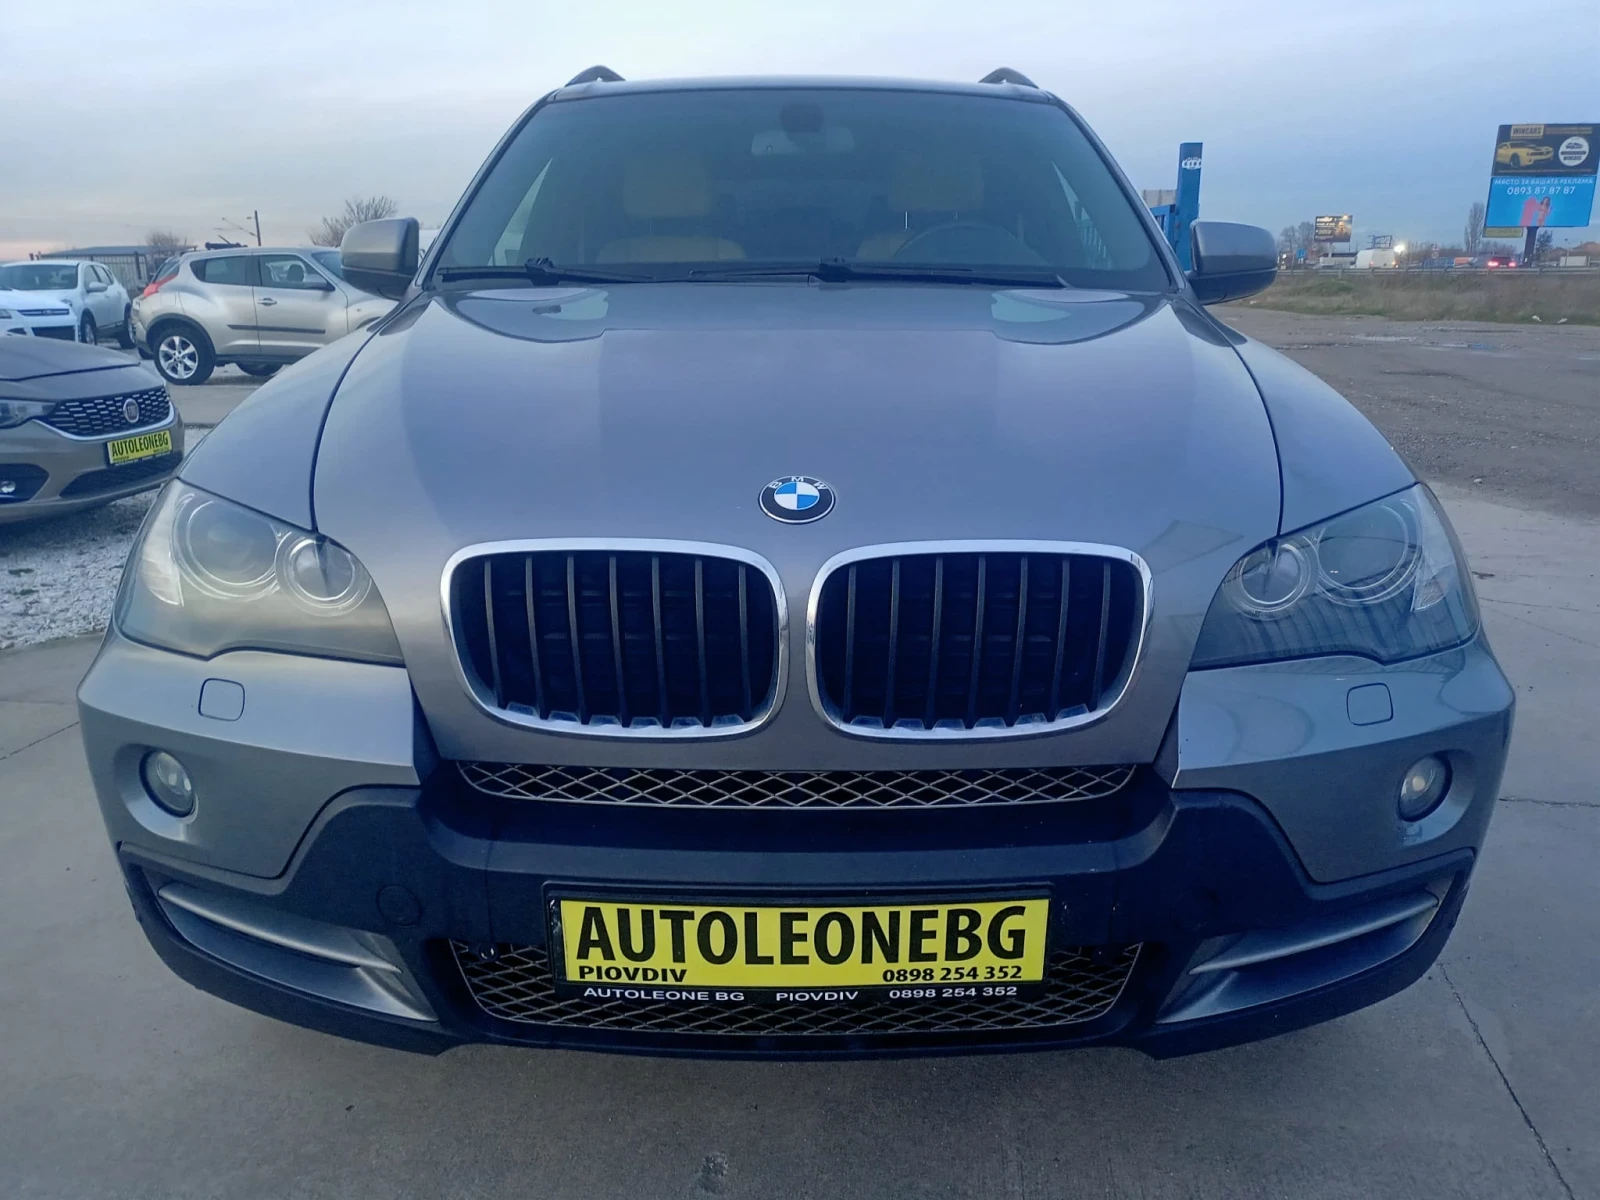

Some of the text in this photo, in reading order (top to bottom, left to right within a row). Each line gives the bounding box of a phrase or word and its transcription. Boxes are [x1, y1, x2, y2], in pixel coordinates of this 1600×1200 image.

[1507, 186, 1576, 195] 0893 87 87 87
[112, 432, 169, 457] AUTOLEONEBG
[768, 476, 828, 489] BMW
[576, 905, 1026, 965] AUTOLEONEBG
[578, 965, 687, 983] PIOVDIV
[882, 965, 1022, 983] 0898 254 352
[583, 987, 745, 1001] AUTOLEONE BG
[776, 991, 858, 1002] PIOVDIV
[889, 986, 1018, 999] 0898 254 352
